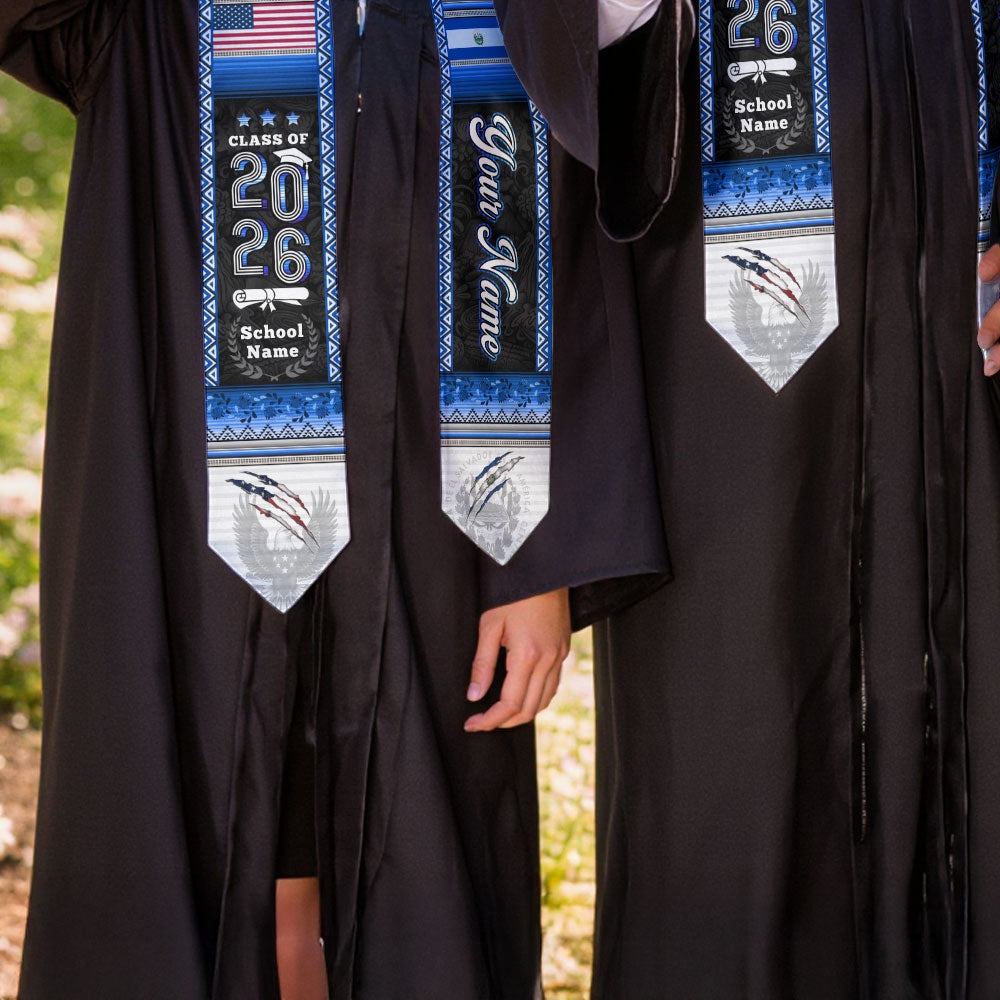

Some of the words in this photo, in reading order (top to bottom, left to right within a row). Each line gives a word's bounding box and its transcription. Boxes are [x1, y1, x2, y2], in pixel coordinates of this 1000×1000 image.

[734, 94, 793, 114] School
[740, 117, 789, 133] Name
[228, 134, 283, 147] CLASS
[287, 133, 309, 145] OF
[469, 112, 518, 223] Your
[230, 151, 310, 224] 20
[232, 218, 311, 284] 26
[477, 223, 519, 361] Name
[240, 323, 304, 341] School
[246, 344, 299, 360] Name
